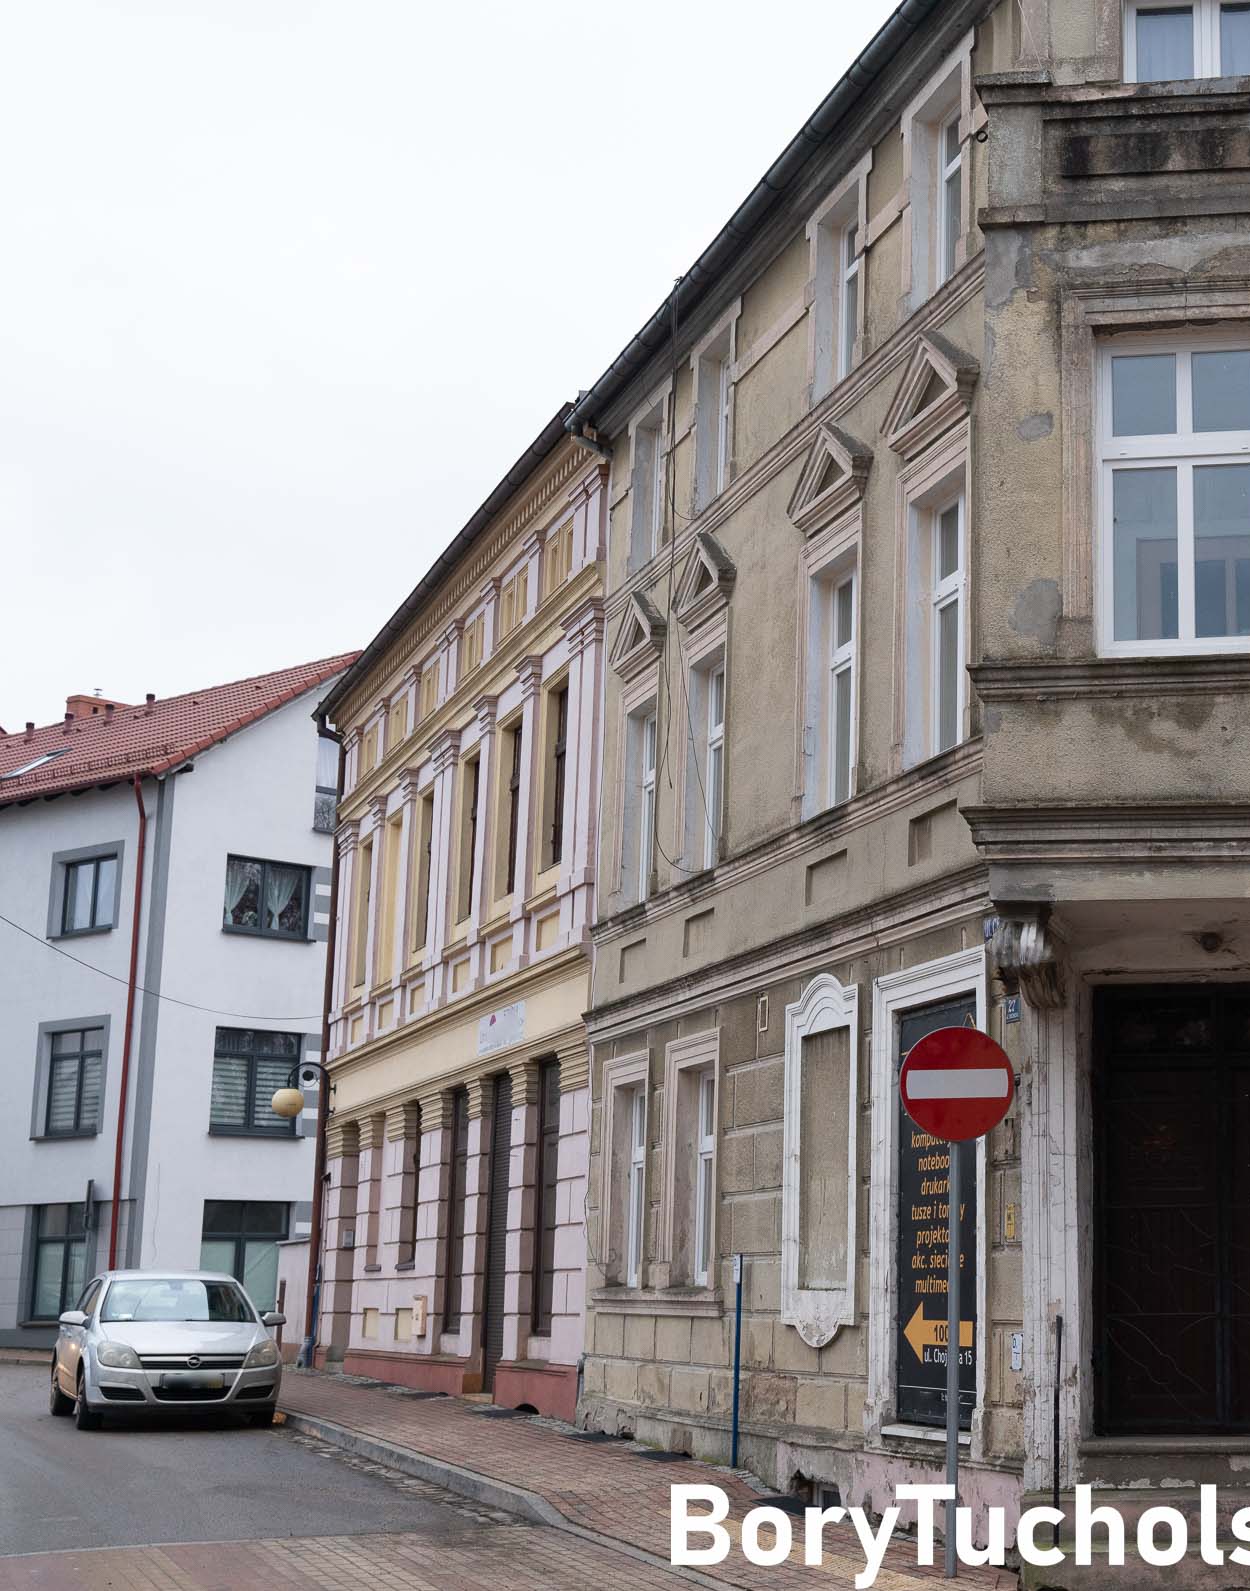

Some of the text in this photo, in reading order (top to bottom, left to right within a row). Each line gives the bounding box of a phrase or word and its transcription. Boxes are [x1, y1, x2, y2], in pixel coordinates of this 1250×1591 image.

[911, 1204, 932, 1220] tusze
[933, 1200, 937, 1219] i
[964, 1350, 973, 1366] 15
